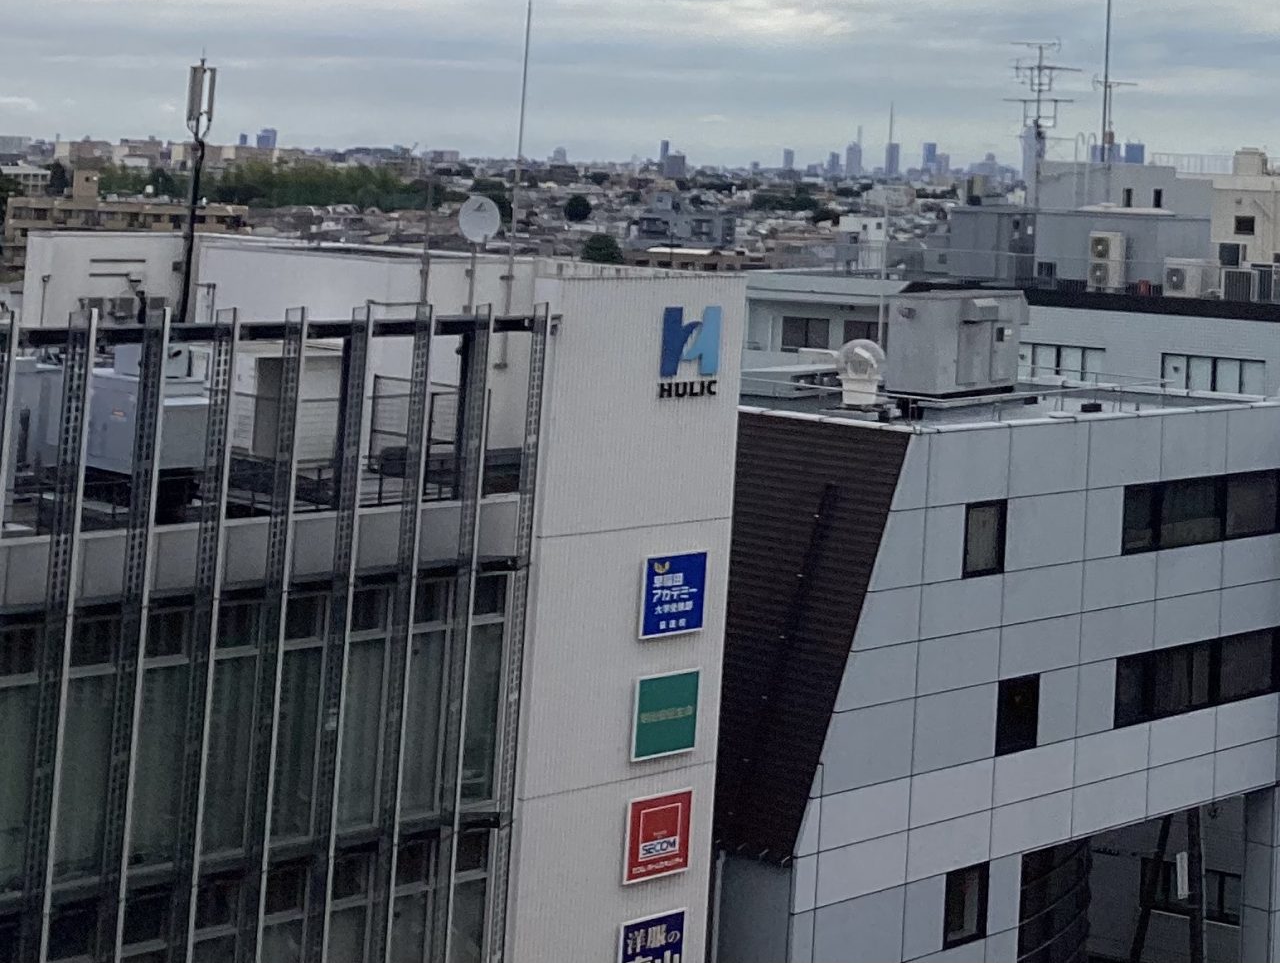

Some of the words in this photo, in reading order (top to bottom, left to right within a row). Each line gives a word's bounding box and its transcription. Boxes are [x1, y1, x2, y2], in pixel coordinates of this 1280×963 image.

[659, 380, 718, 399] HULIC
[652, 586, 698, 603] アカデミー
[641, 838, 677, 855] SECOM
[626, 923, 681, 955] 洋服の
